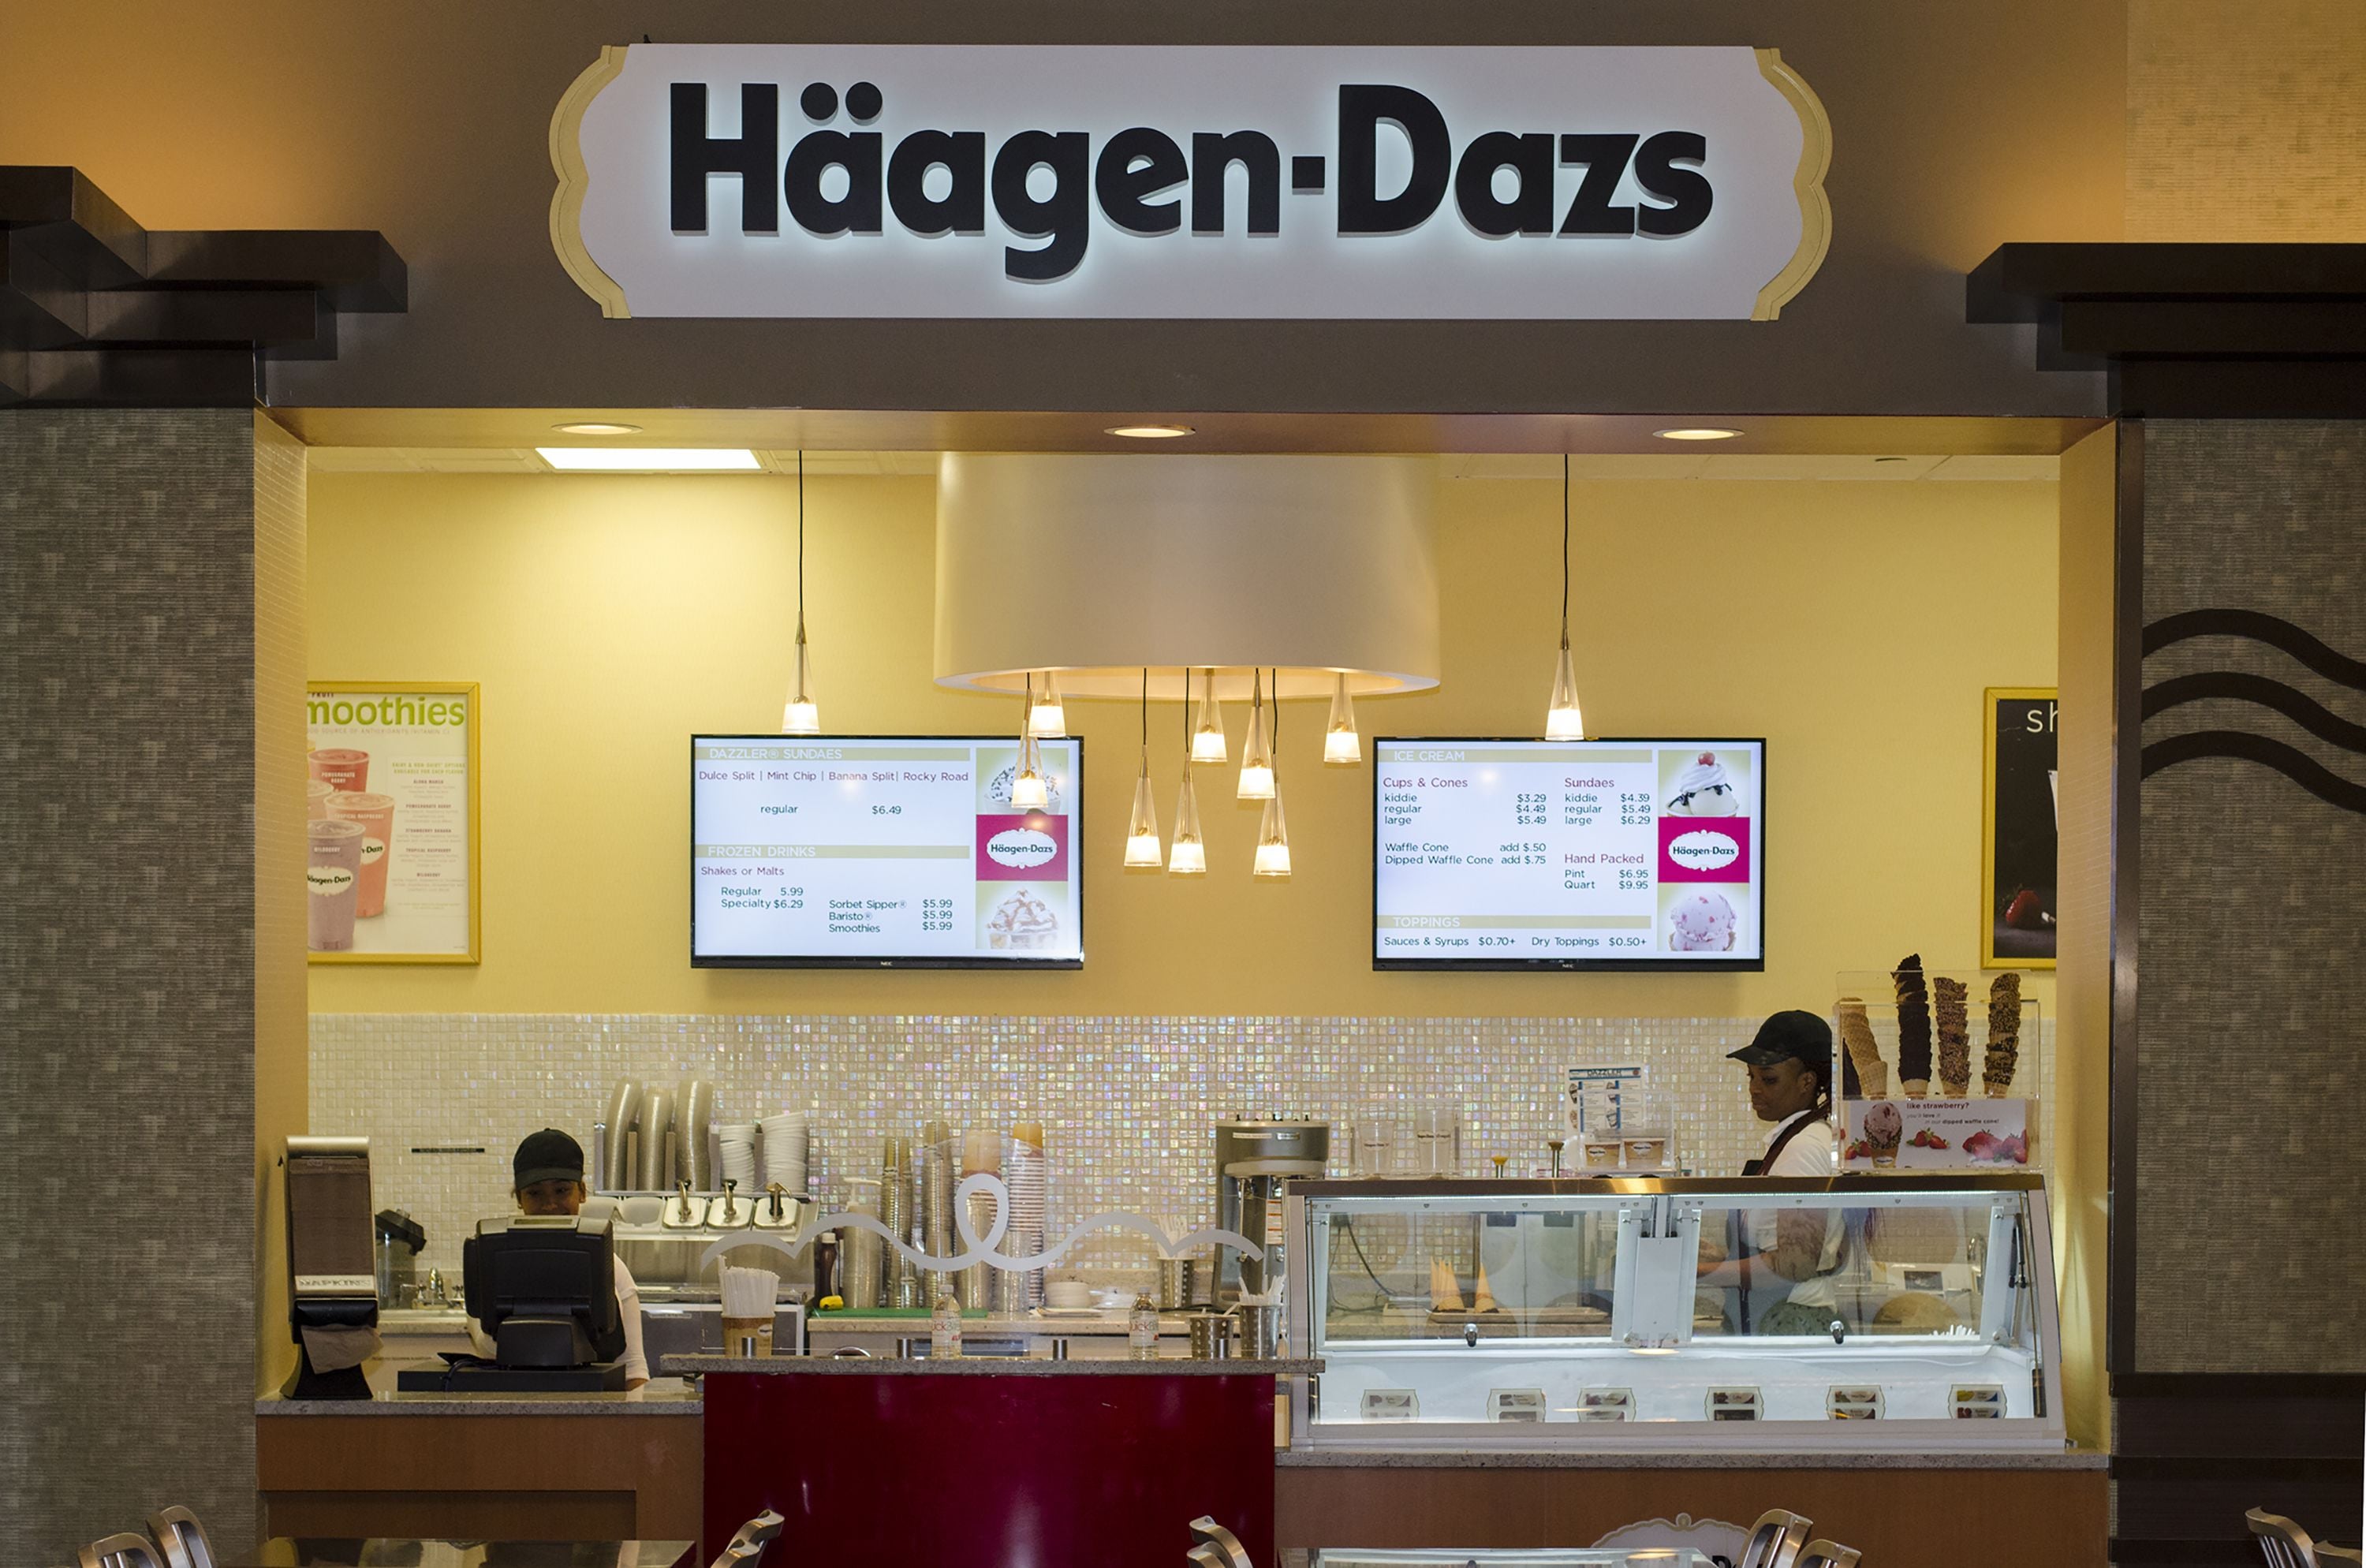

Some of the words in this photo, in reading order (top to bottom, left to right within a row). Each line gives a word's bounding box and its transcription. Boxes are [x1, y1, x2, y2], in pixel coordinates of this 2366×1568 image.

[670, 83, 1712, 284] Häagen-Dazs
[783, 749, 842, 760] SUNDAES
[1394, 751, 1414, 761] ICE
[1419, 751, 1465, 761] CREAM
[699, 771, 728, 781] Dulce
[732, 771, 755, 782] Split
[767, 771, 789, 781] Mint
[793, 771, 817, 782] Chip
[828, 772, 868, 782] Banana
[903, 772, 937, 783] Rocky
[941, 772, 968, 782] Road
[1564, 777, 1614, 788] Sundaes
[1383, 777, 1413, 790] Cups
[1417, 778, 1426, 788] &
[1431, 777, 1468, 788] Cones
[1384, 793, 1417, 802] kiddie
[1517, 793, 1547, 803] $3.29
[1565, 793, 1598, 802] kiddie
[1620, 793, 1650, 803] $4.39
[760, 805, 799, 816] regular
[871, 805, 902, 815] $6.49
[1384, 805, 1422, 816] regular
[1516, 804, 1546, 814] $4.49
[1564, 804, 1603, 815] regular
[1621, 804, 1651, 814] $5.49
[1384, 816, 1412, 827] large
[1517, 816, 1547, 825] $5.49
[1565, 815, 1592, 826] large
[1621, 815, 1651, 826] $6.29
[708, 846, 762, 857] FROZEN
[767, 846, 815, 857] DRINKS
[991, 843, 1053, 855] Häagen-Dazs
[1385, 842, 1419, 852] Waffle
[1422, 842, 1449, 852] Cone
[1499, 842, 1519, 852] add
[1522, 842, 1547, 853] $.50
[1672, 846, 1735, 857] Häagen-Dazs
[1385, 855, 1424, 866] Dipped
[1427, 855, 1462, 864] Waffle
[1466, 855, 1494, 864] Cone
[1501, 855, 1521, 864] add
[1524, 855, 1547, 865] $.75
[1564, 853, 1595, 864] Hand
[1600, 853, 1644, 864] Packed
[701, 866, 737, 875] Shakes
[757, 866, 785, 875] Malts
[1564, 869, 1585, 879] Pint
[1619, 868, 1649, 879] $6.95
[1564, 880, 1595, 890] Quart
[1619, 880, 1649, 890] $9.95
[721, 887, 762, 898] Regular
[780, 887, 804, 896] 5.99
[721, 898, 771, 909] Specialty
[773, 898, 804, 909] $6.29
[829, 900, 863, 909] Sorbet
[922, 899, 953, 909] $5.99
[922, 910, 953, 920] $5.99
[828, 924, 881, 933] Smoothies
[922, 921, 953, 931] $5.99
[1393, 917, 1461, 928] TOPPINGS
[1384, 936, 1422, 946] Sauces
[1424, 937, 1431, 946] &
[1435, 936, 1469, 948] Syrups
[1479, 936, 1516, 947] $0.70+
[1532, 936, 1551, 948] Dry
[1555, 936, 1599, 948] Toppings
[1609, 936, 1647, 947] $0.50+
[300, 1279, 371, 1287] NAPKINS
